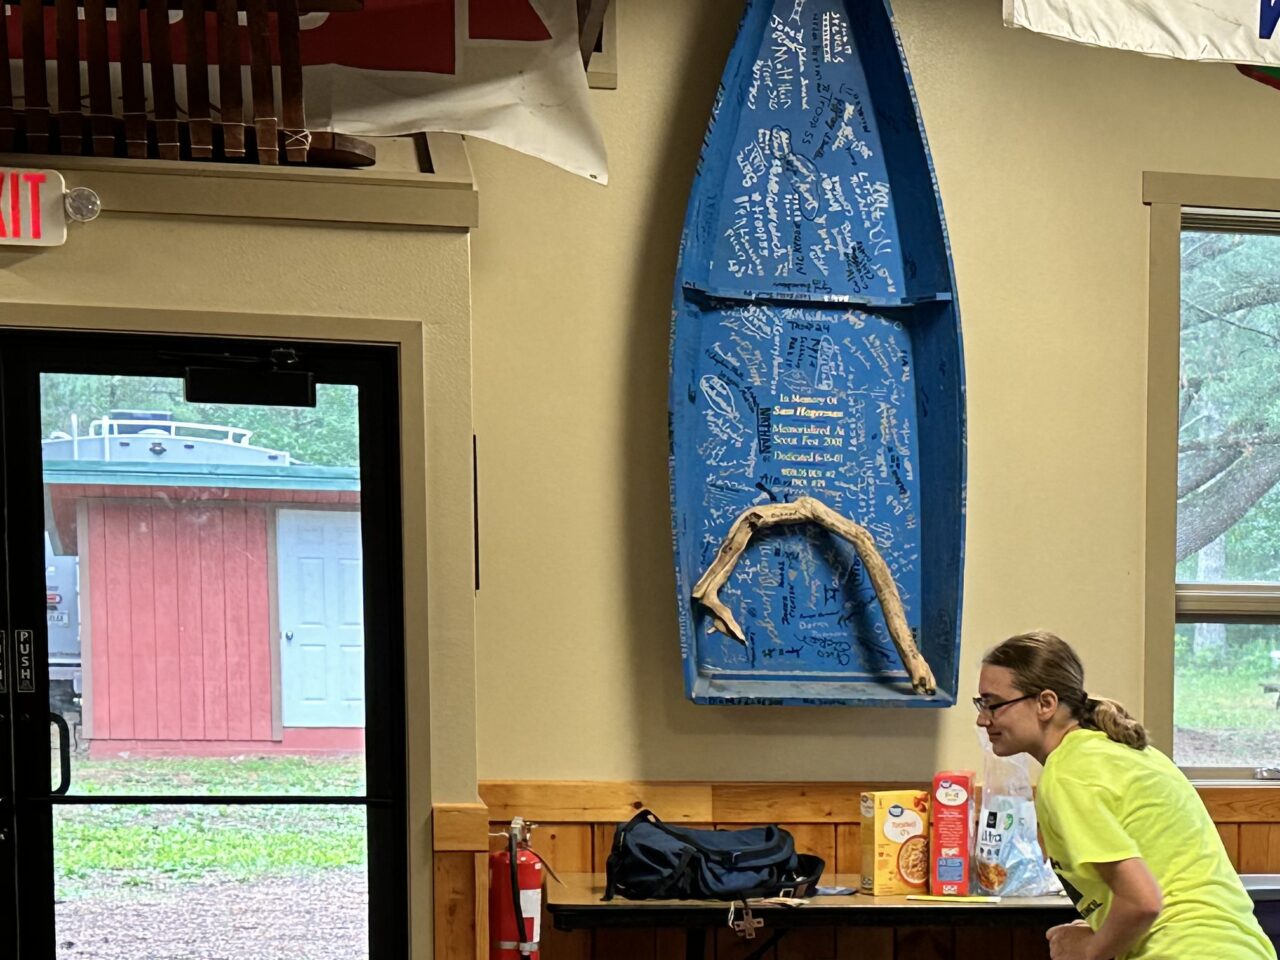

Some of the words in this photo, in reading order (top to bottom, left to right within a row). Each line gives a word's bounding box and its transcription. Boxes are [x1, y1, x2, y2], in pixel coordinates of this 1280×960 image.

[791, 393, 826, 406] Memory
[773, 434, 798, 446] Scout
[20, 631, 31, 680] PUSH
